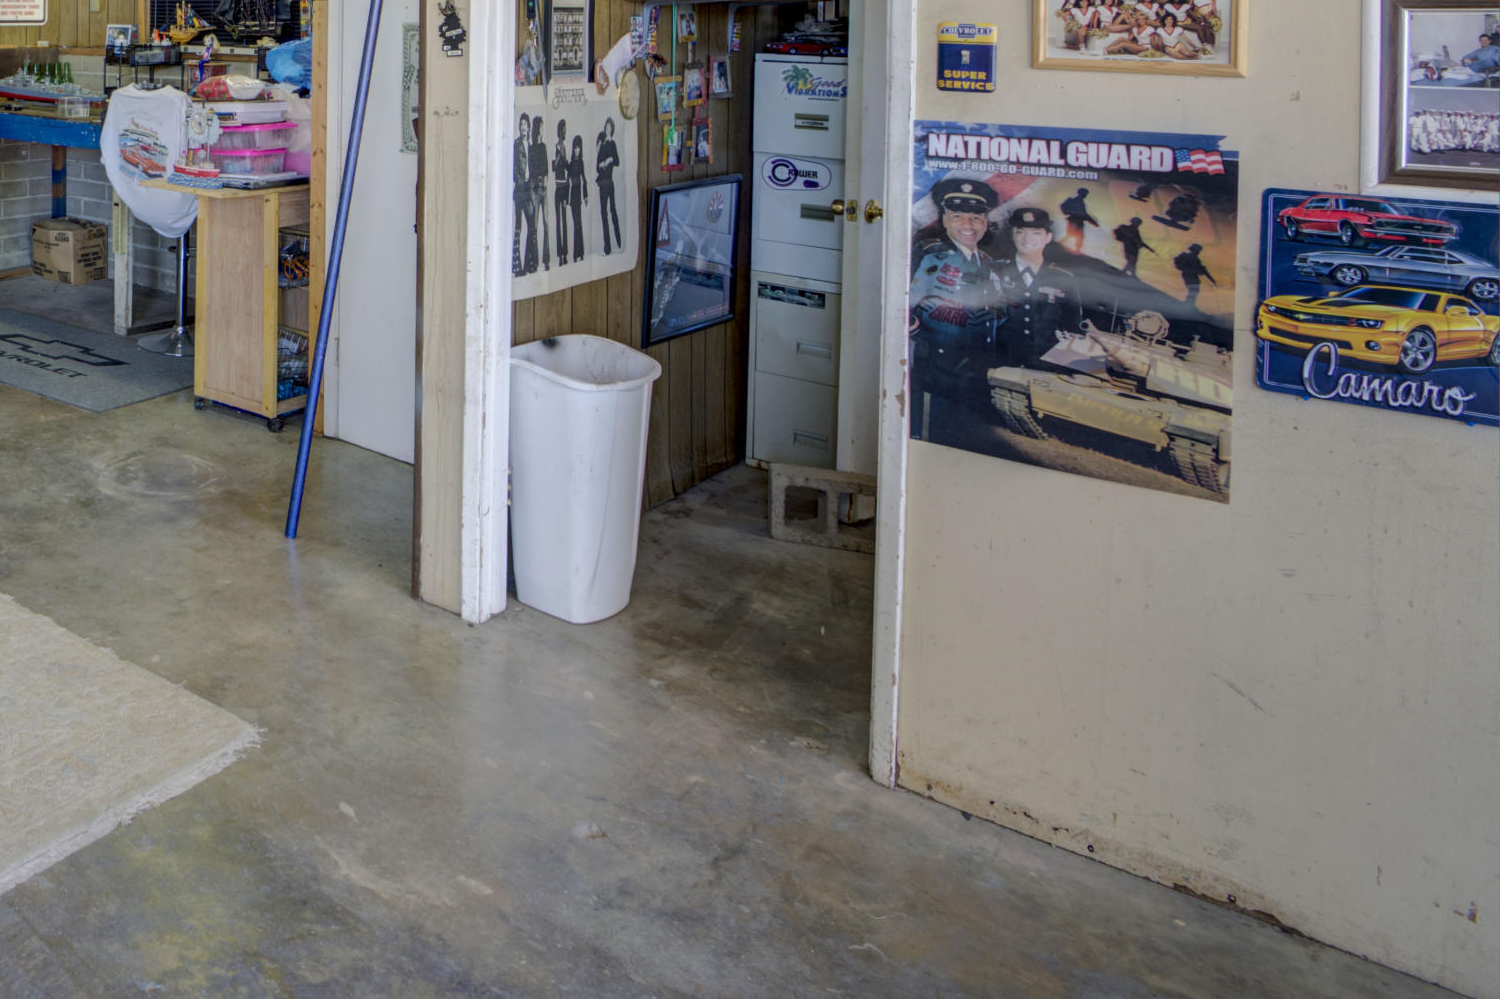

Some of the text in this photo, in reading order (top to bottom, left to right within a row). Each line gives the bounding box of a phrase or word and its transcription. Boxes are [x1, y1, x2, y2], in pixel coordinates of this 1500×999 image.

[942, 26, 992, 35] CHEVROLET
[943, 69, 987, 80] SUPER
[938, 80, 994, 91] SERVICE
[927, 133, 1175, 173] NATIONAL GUARD
[928, 159, 1099, 181] www.1-800-GO-GUARD.com
[1302, 341, 1477, 417] Camaro
